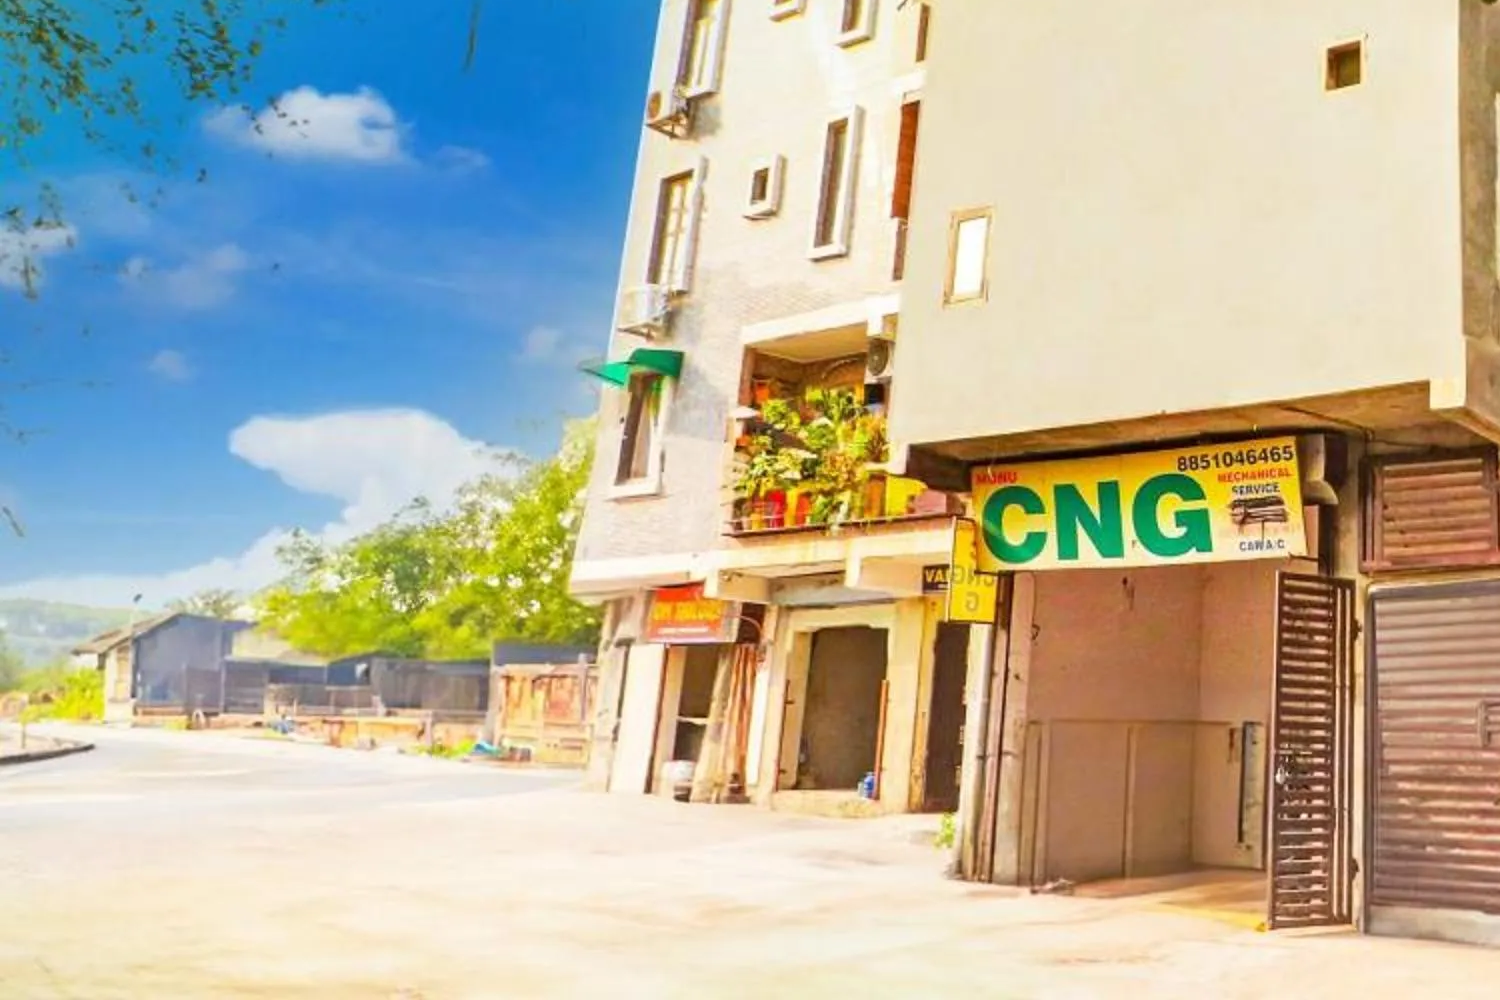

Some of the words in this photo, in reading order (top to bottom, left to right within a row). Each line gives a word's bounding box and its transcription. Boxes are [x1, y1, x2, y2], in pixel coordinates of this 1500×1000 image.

[1177, 445, 1294, 472] 8851046465
[1217, 467, 1293, 483] MECHANICAL
[1232, 482, 1280, 495] SERVICE
[981, 473, 1213, 564] CNG
